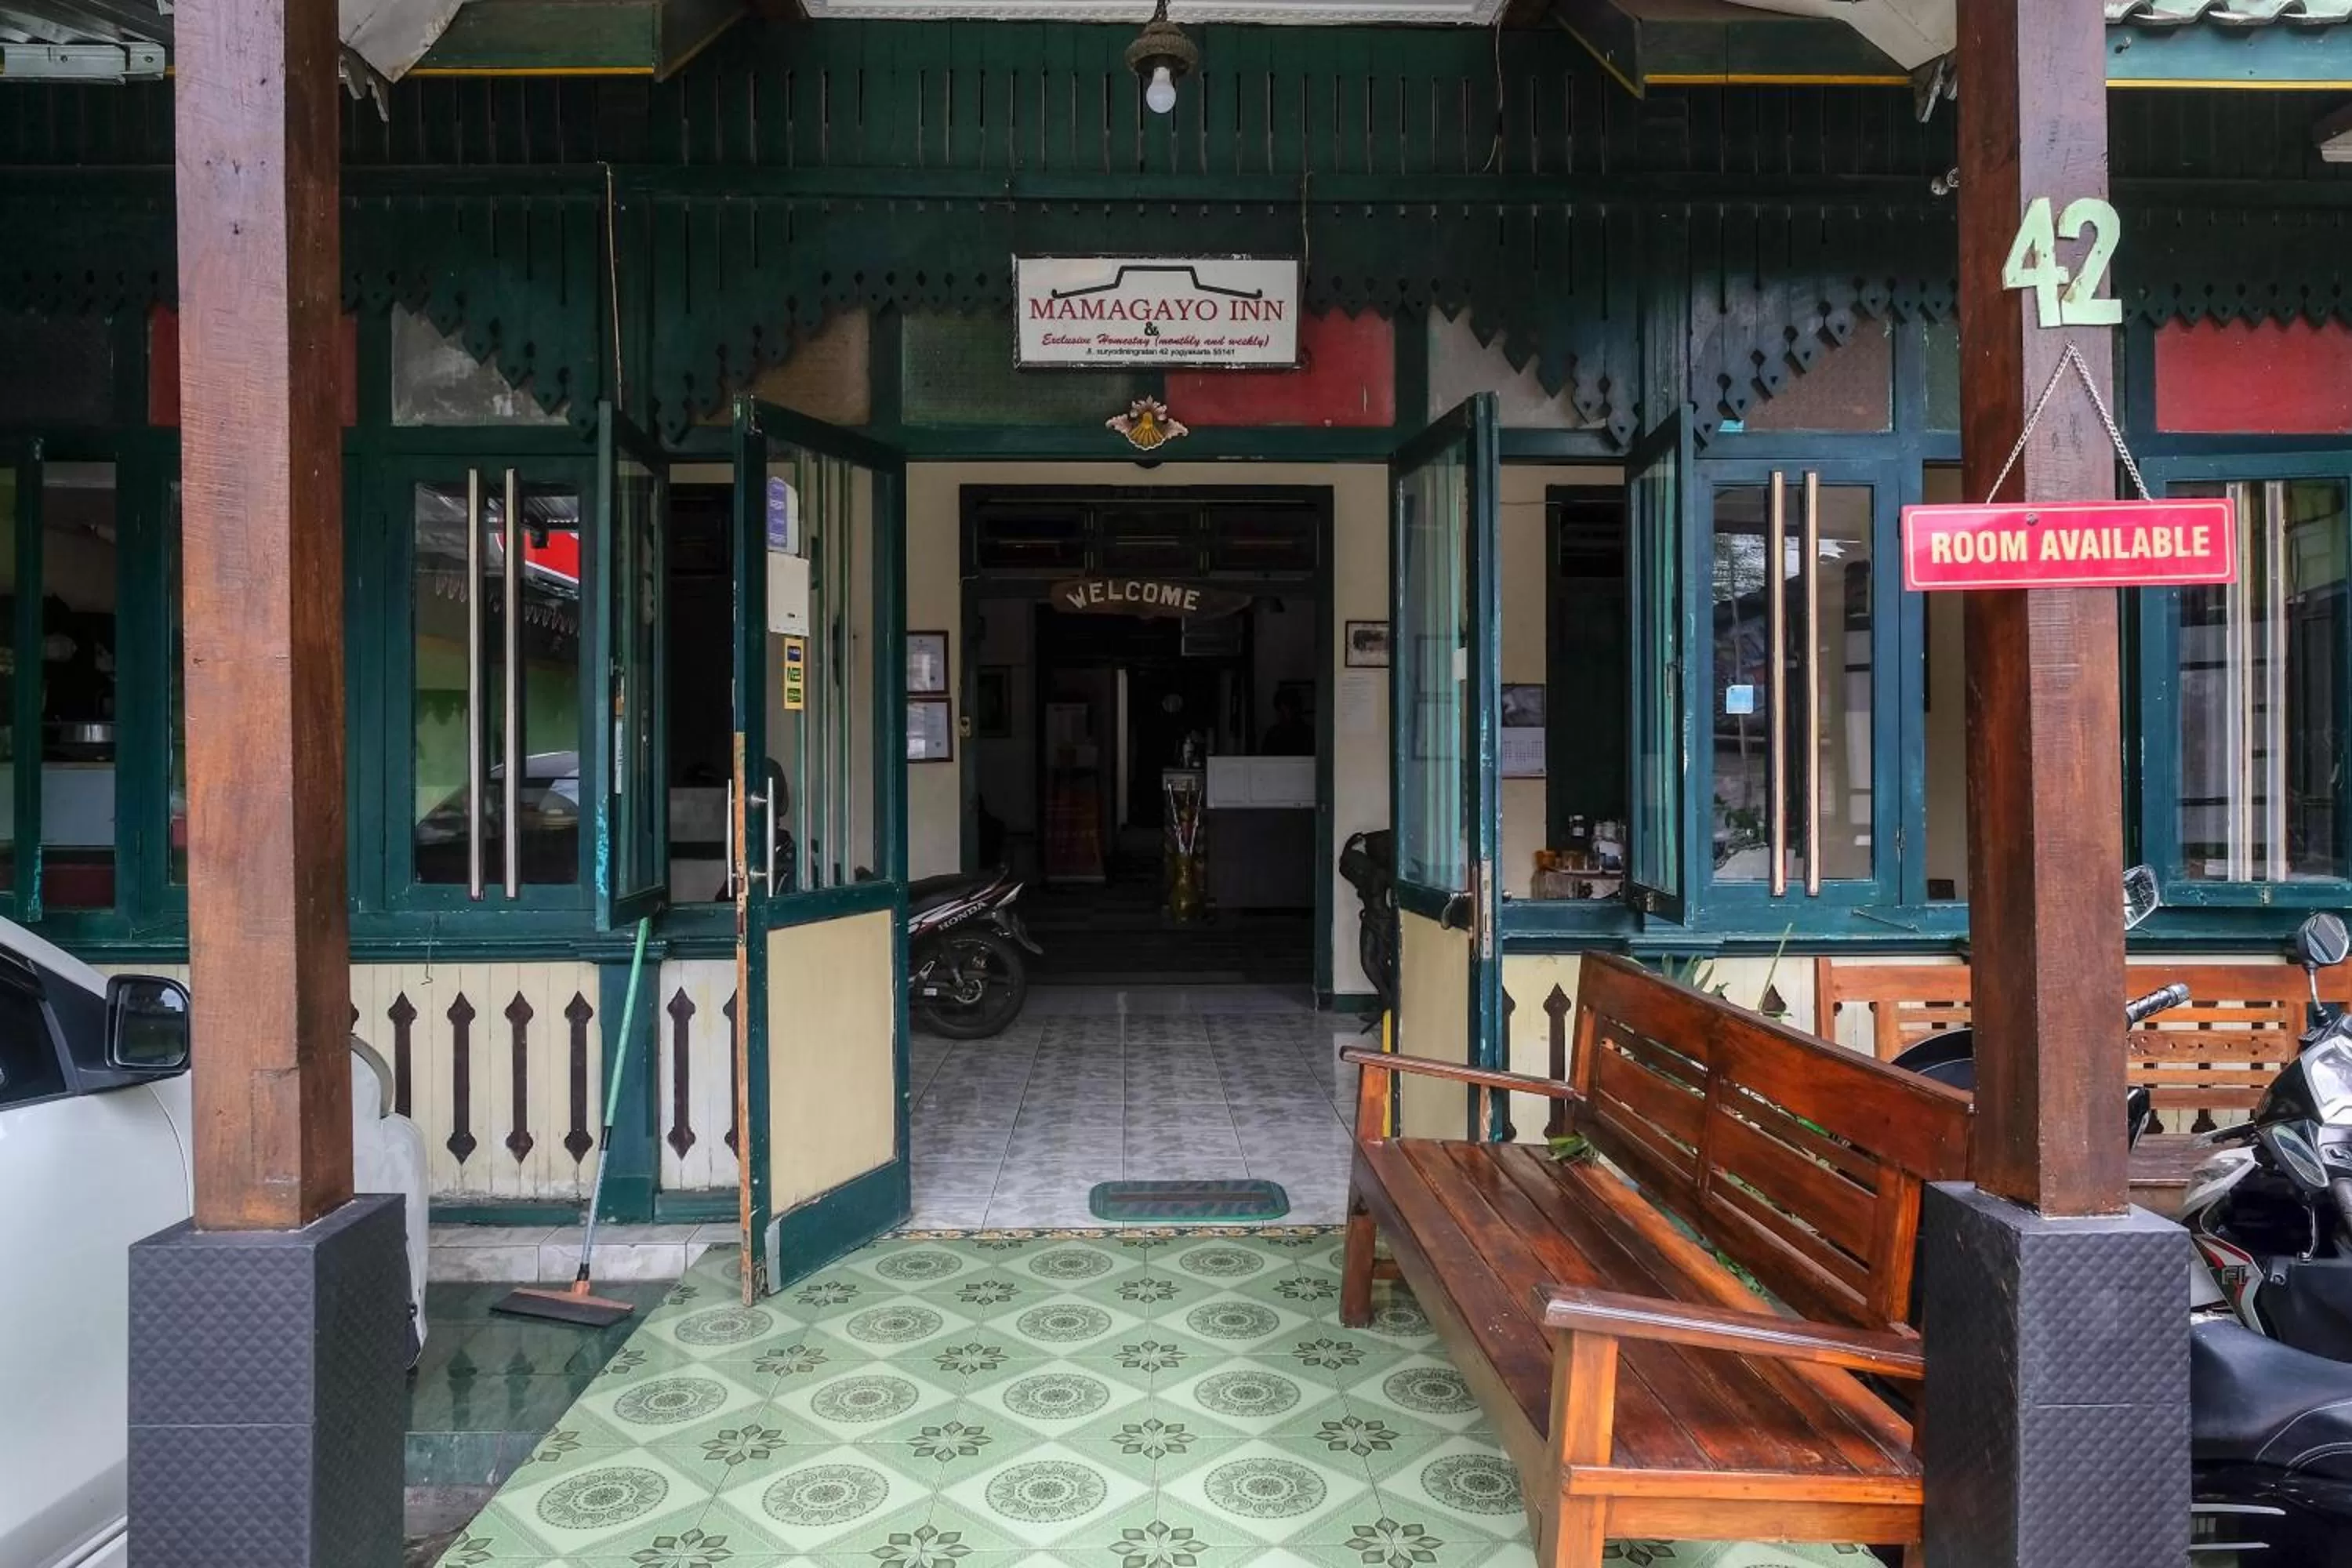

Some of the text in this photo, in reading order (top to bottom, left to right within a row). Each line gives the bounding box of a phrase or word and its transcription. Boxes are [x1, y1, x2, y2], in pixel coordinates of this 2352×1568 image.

[2002, 197, 2122, 328] 42
[1029, 299, 1285, 321] MAMAGAYO INN
[1042, 333, 1269, 348] Exclusive Homestay (monthly and weekly)
[1144, 321, 1159, 336] &
[1171, 348, 1210, 357] yogyakarta
[1931, 526, 2210, 564] ROOM AVAILABLE
[1066, 580, 1200, 611] WELCOME
[938, 899, 988, 931] HONDA
